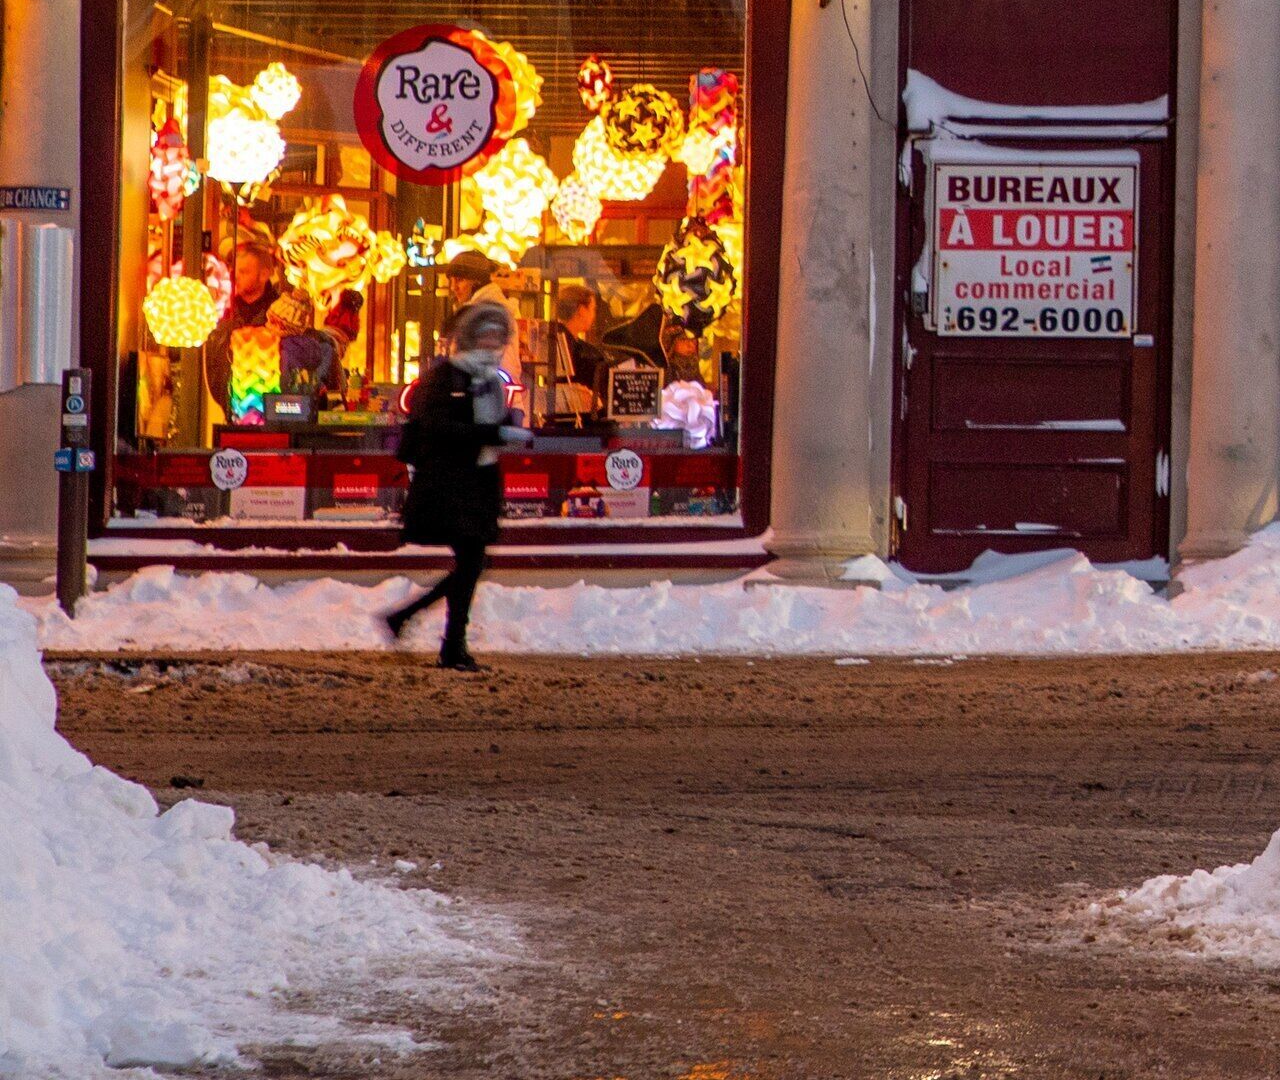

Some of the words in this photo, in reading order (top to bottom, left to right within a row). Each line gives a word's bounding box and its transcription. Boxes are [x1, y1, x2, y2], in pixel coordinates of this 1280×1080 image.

[395, 65, 480, 104] Rare
[426, 103, 453, 133] &
[390, 119, 484, 157] DIFFERENT
[15, 188, 58, 209] CHANGE
[948, 176, 1121, 204] BUREAUX
[947, 206, 974, 246] À
[992, 214, 1124, 247] LOUER
[1000, 255, 1071, 277] Local
[955, 279, 1115, 301] commercial
[957, 306, 1124, 333] 692-6000
